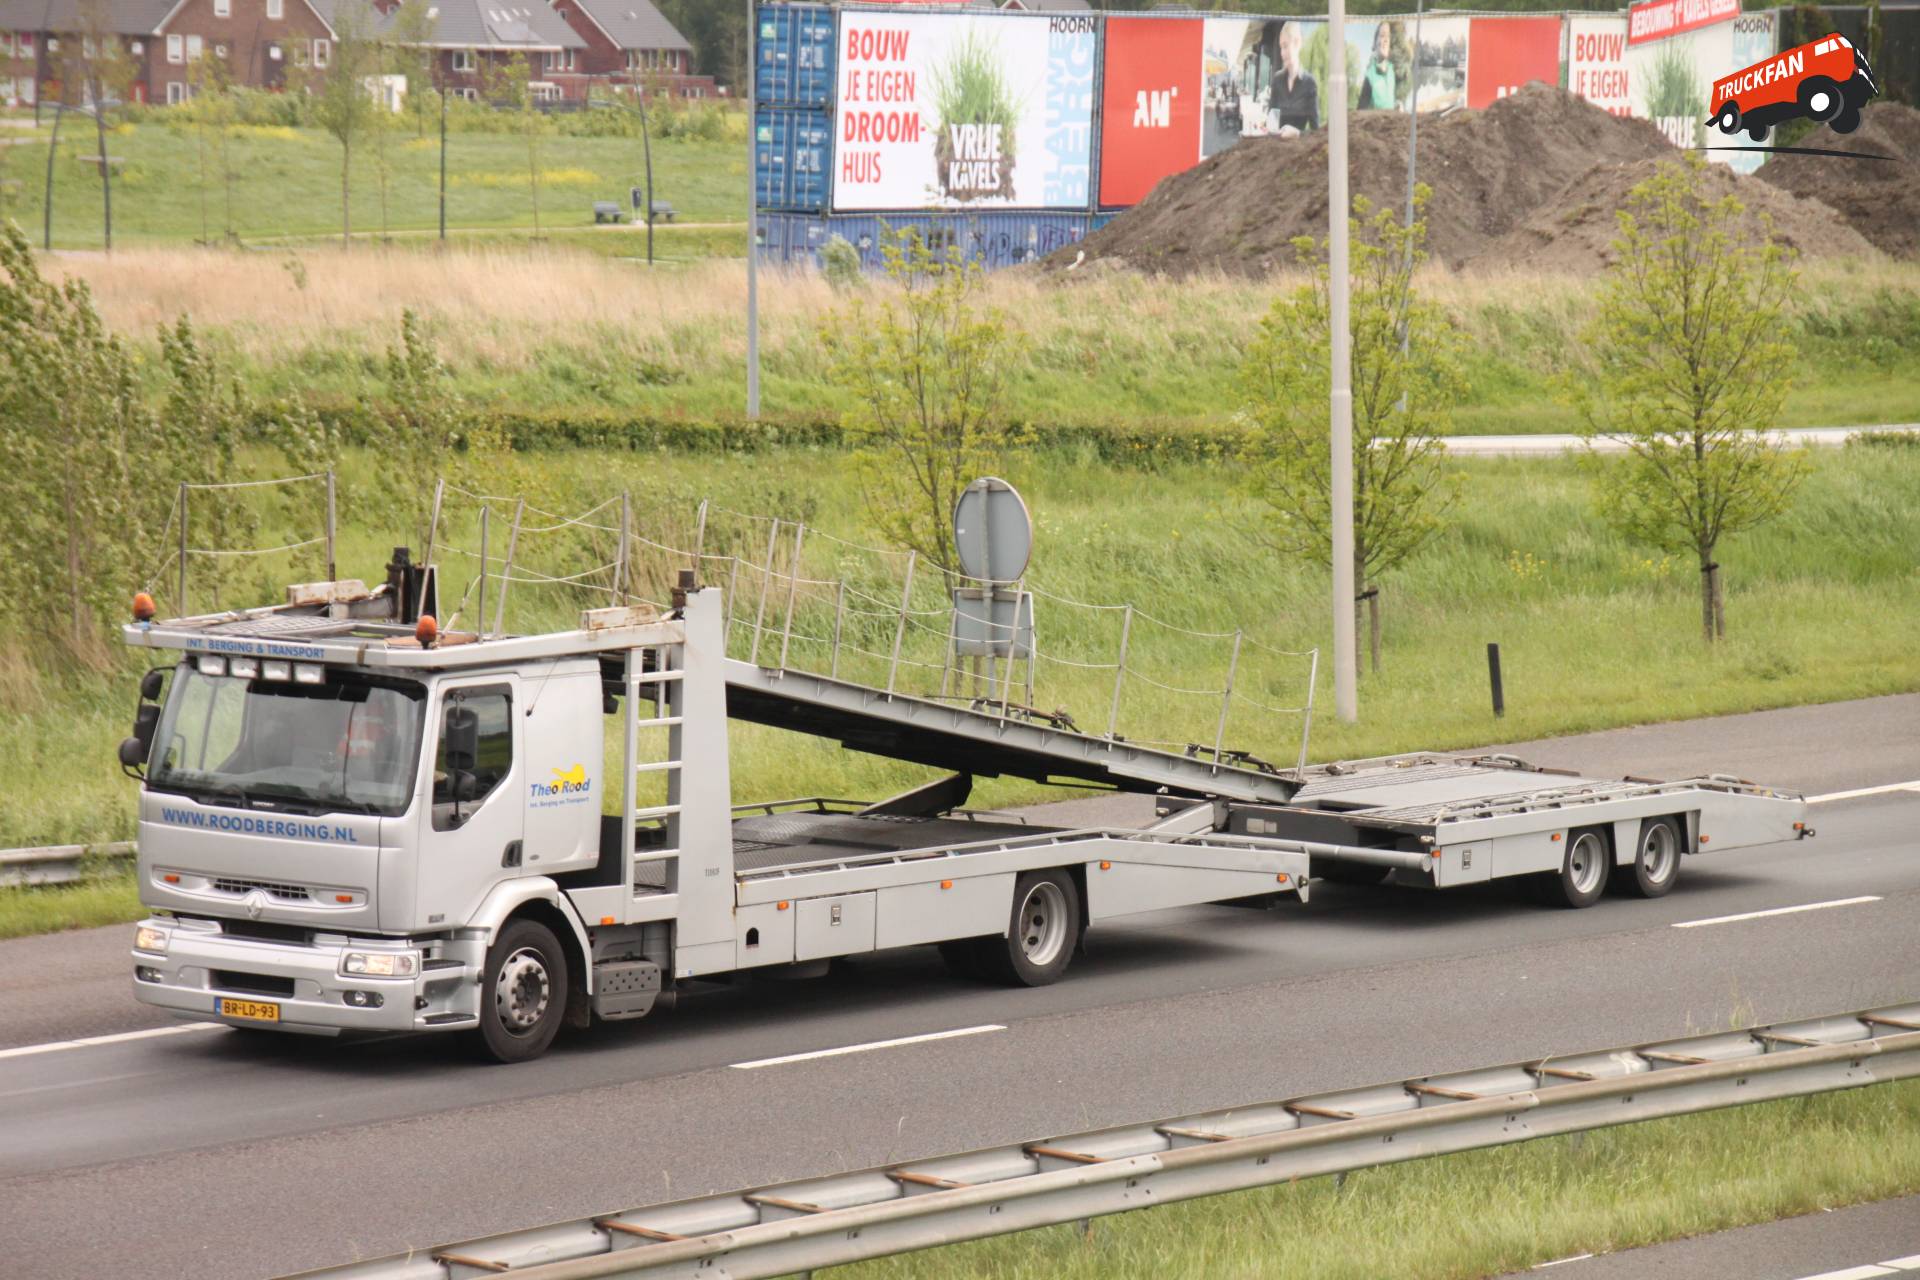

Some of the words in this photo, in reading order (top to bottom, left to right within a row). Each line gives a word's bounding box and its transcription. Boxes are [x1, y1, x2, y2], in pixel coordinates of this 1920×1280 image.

[1050, 17, 1095, 33] HOORN
[1733, 18, 1771, 33] HOORN
[847, 29, 910, 62] BOUW
[1576, 34, 1624, 62] BOUW
[844, 71, 861, 102] JE
[867, 71, 915, 102] EIGEN
[1591, 70, 1629, 98] EIGEN
[844, 111, 926, 143] DROOM-
[950, 123, 1002, 160] VRIJE
[842, 152, 881, 183] HUIS
[949, 161, 1001, 190] KAVELS
[208, 640, 253, 653] BERGING
[256, 643, 264, 654] &
[267, 644, 325, 658] TRANSPORT
[530, 783, 559, 797] Theo
[562, 778, 591, 794] Rood
[162, 808, 357, 842] WWW.ROODBERGING.NL
[224, 1001, 274, 1018] BR-LD-93
